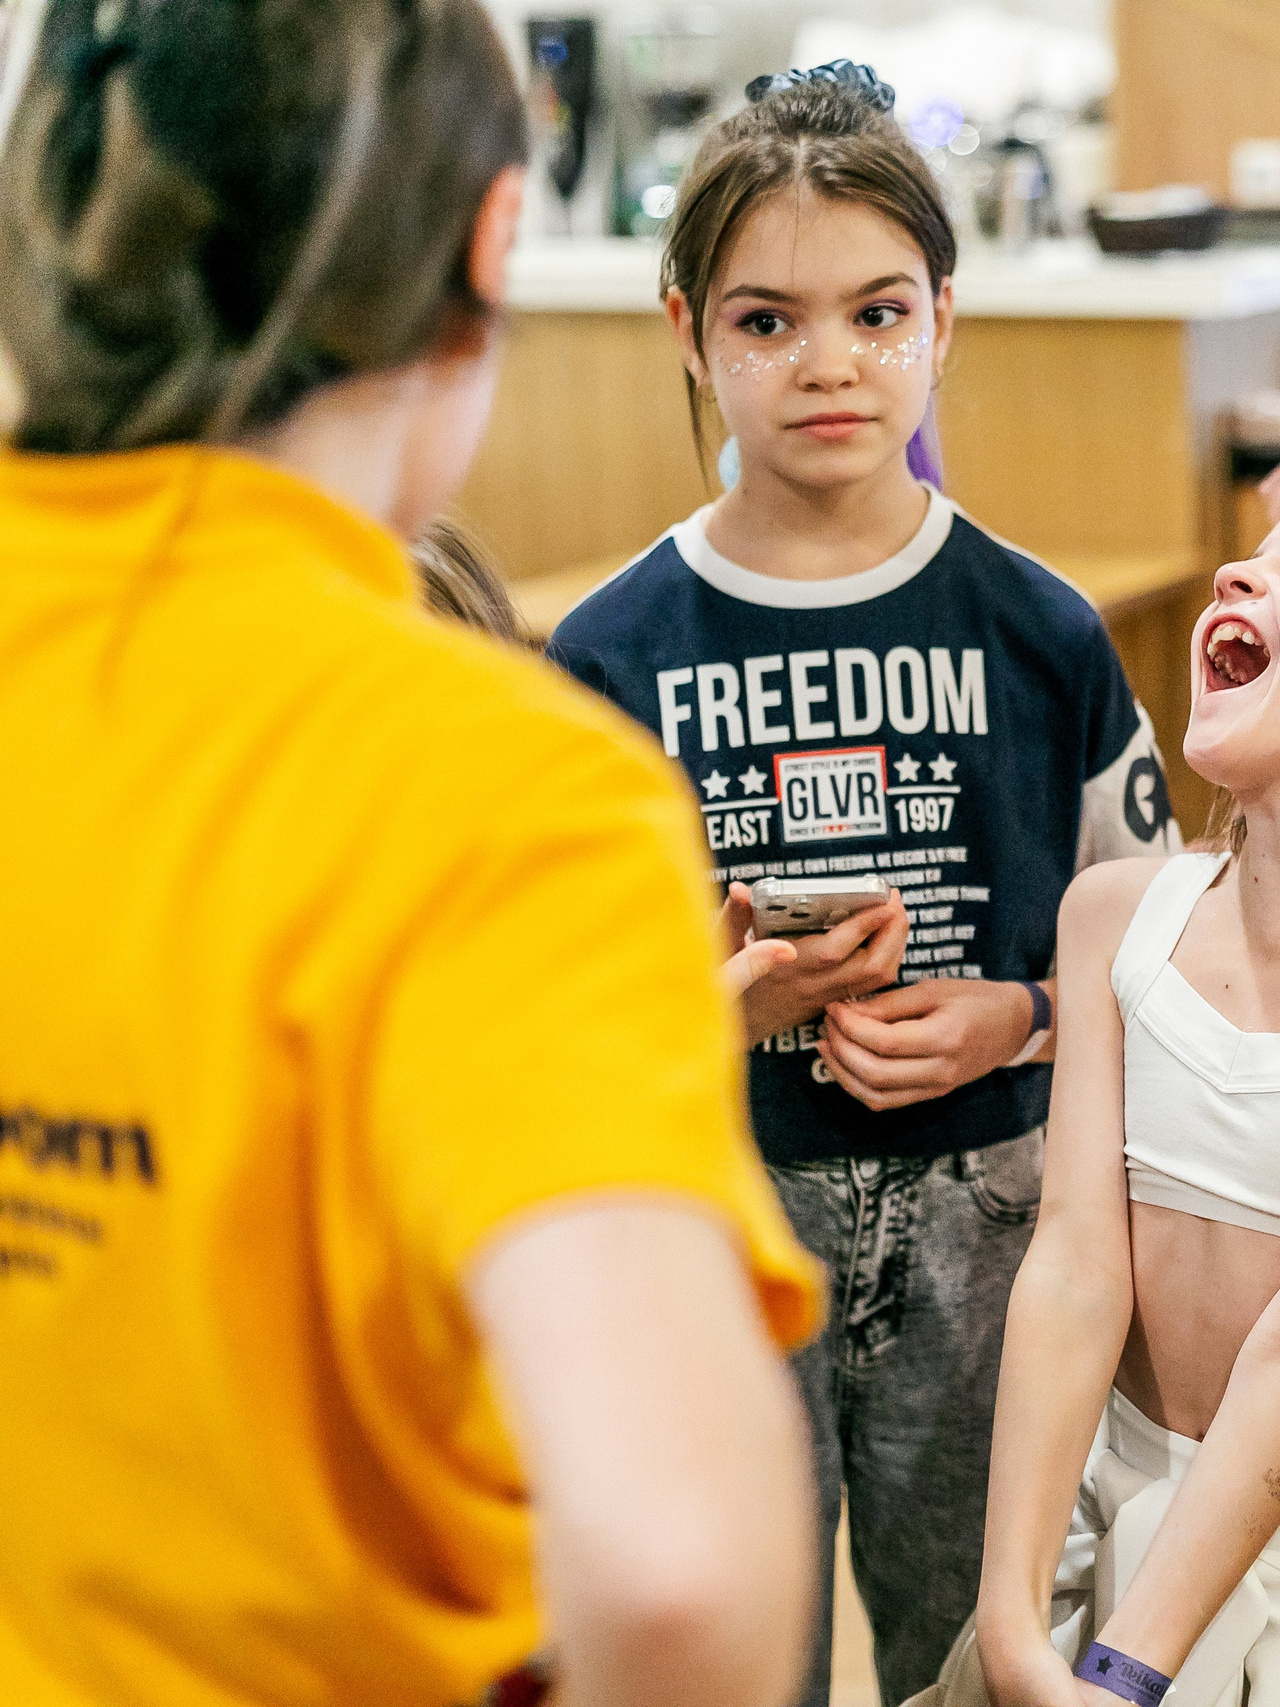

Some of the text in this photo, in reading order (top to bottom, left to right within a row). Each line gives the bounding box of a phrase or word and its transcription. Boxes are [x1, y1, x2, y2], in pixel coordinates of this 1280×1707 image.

[657, 646, 988, 757] FREEDOM
[786, 772, 879, 821] GLVR
[895, 797, 955, 834] 1997
[706, 810, 772, 850] EAST
